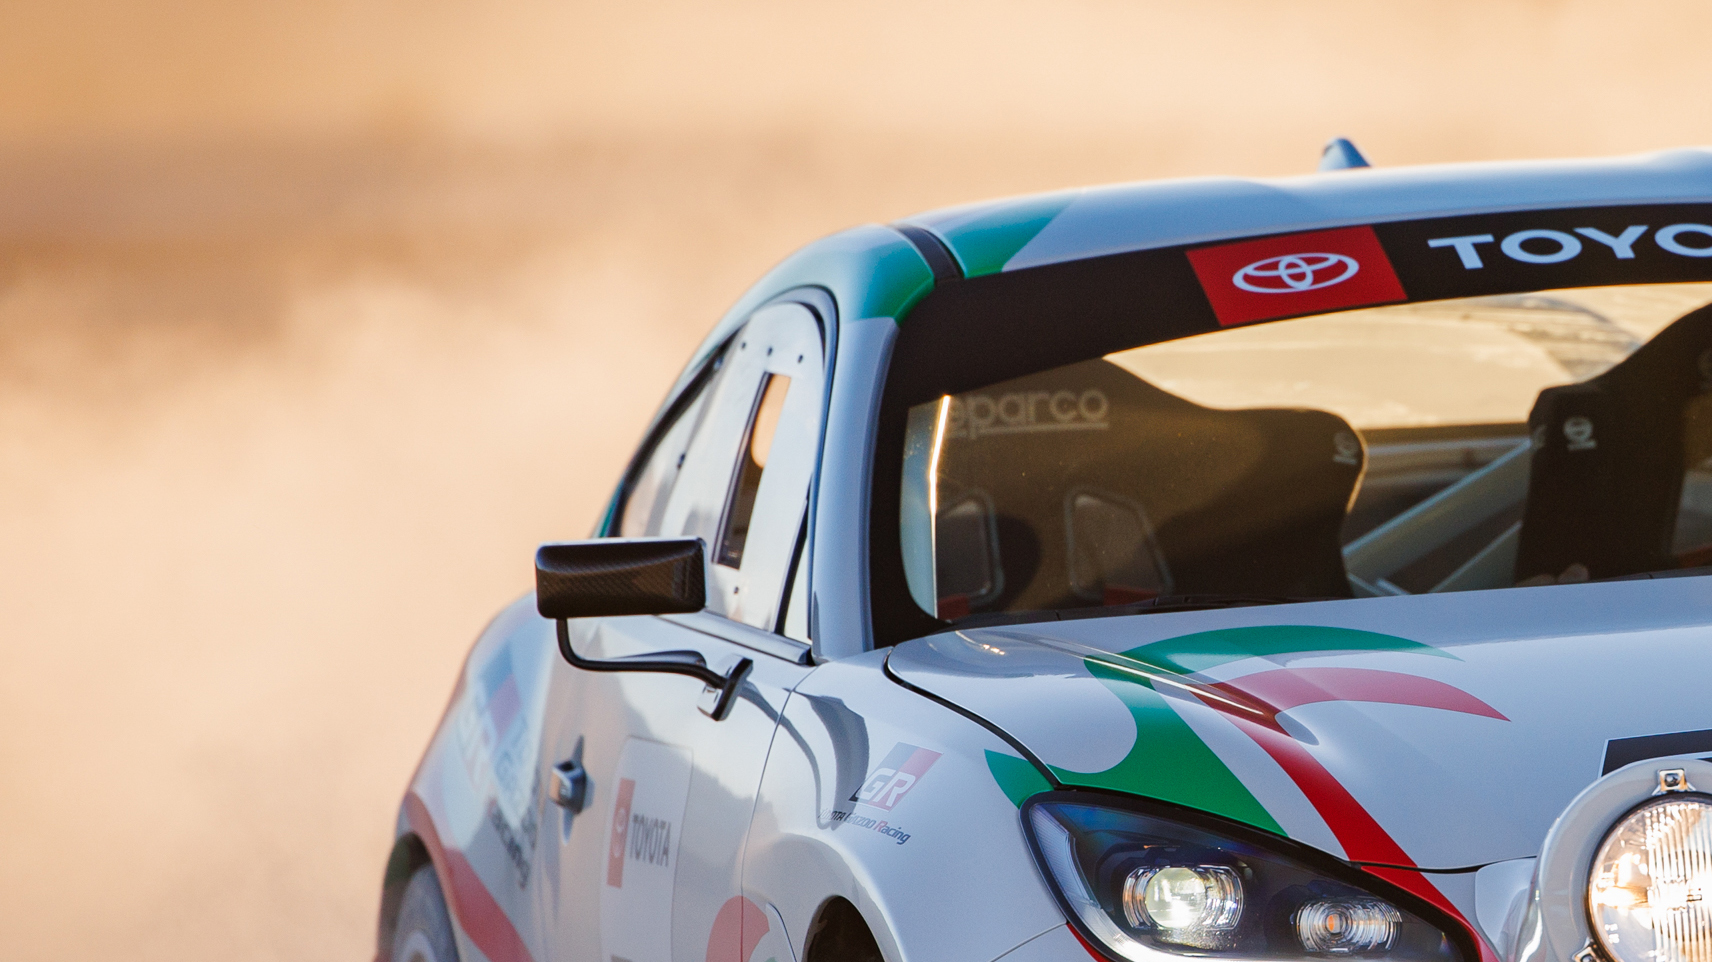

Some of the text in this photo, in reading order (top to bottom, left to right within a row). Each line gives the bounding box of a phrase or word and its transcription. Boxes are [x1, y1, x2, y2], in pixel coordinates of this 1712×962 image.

[855, 767, 916, 807] GR
[629, 812, 671, 867] TOYOTA
[873, 820, 911, 845] Racing
